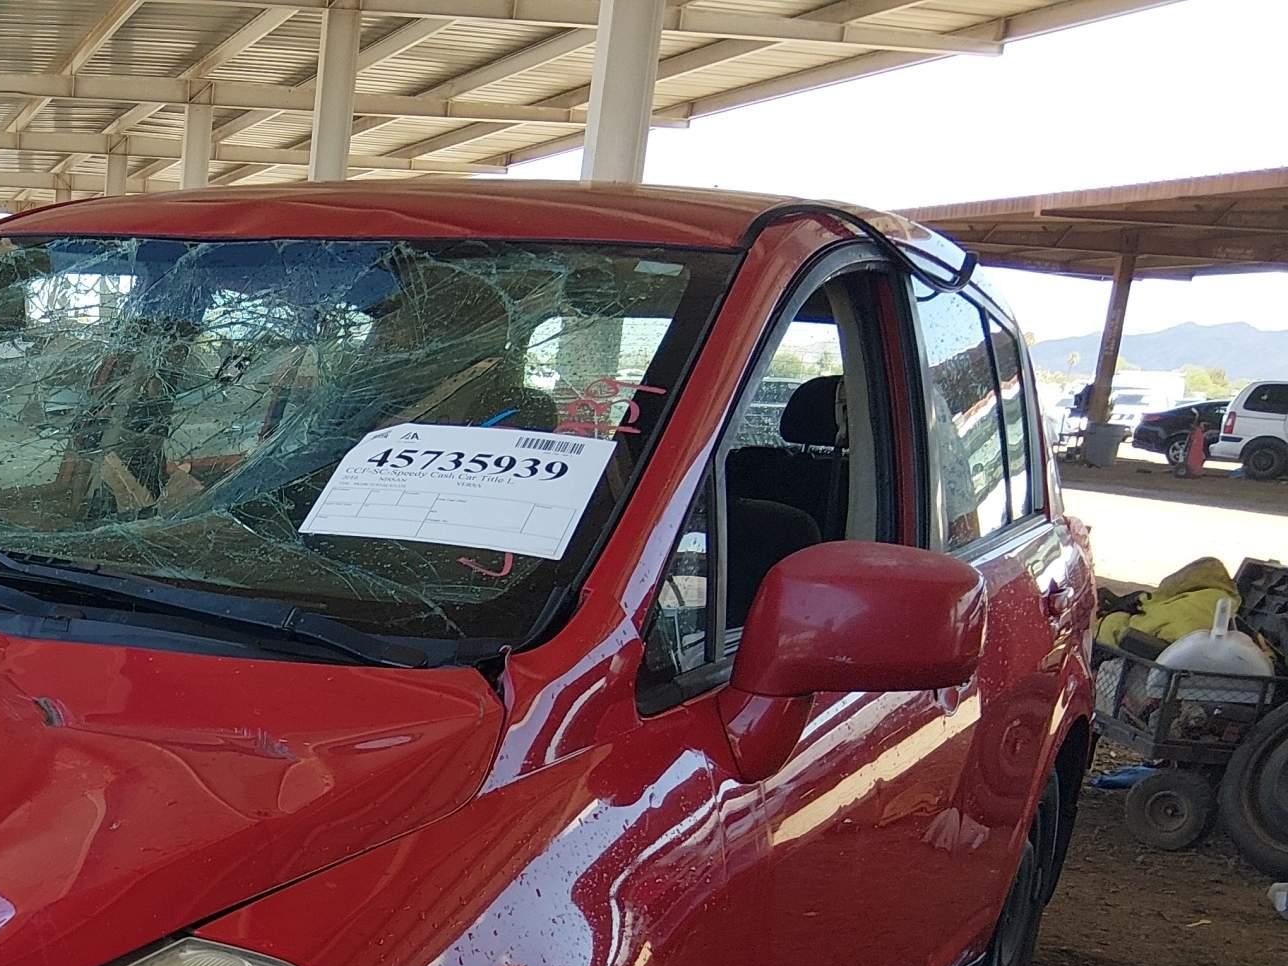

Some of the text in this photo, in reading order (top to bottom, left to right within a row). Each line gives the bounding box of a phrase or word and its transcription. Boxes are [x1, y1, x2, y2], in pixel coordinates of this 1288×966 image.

[367, 448, 569, 481] 45735939
[429, 471, 455, 480] Cash
[458, 473, 477, 481] Car
[481, 474, 505, 484] Title
